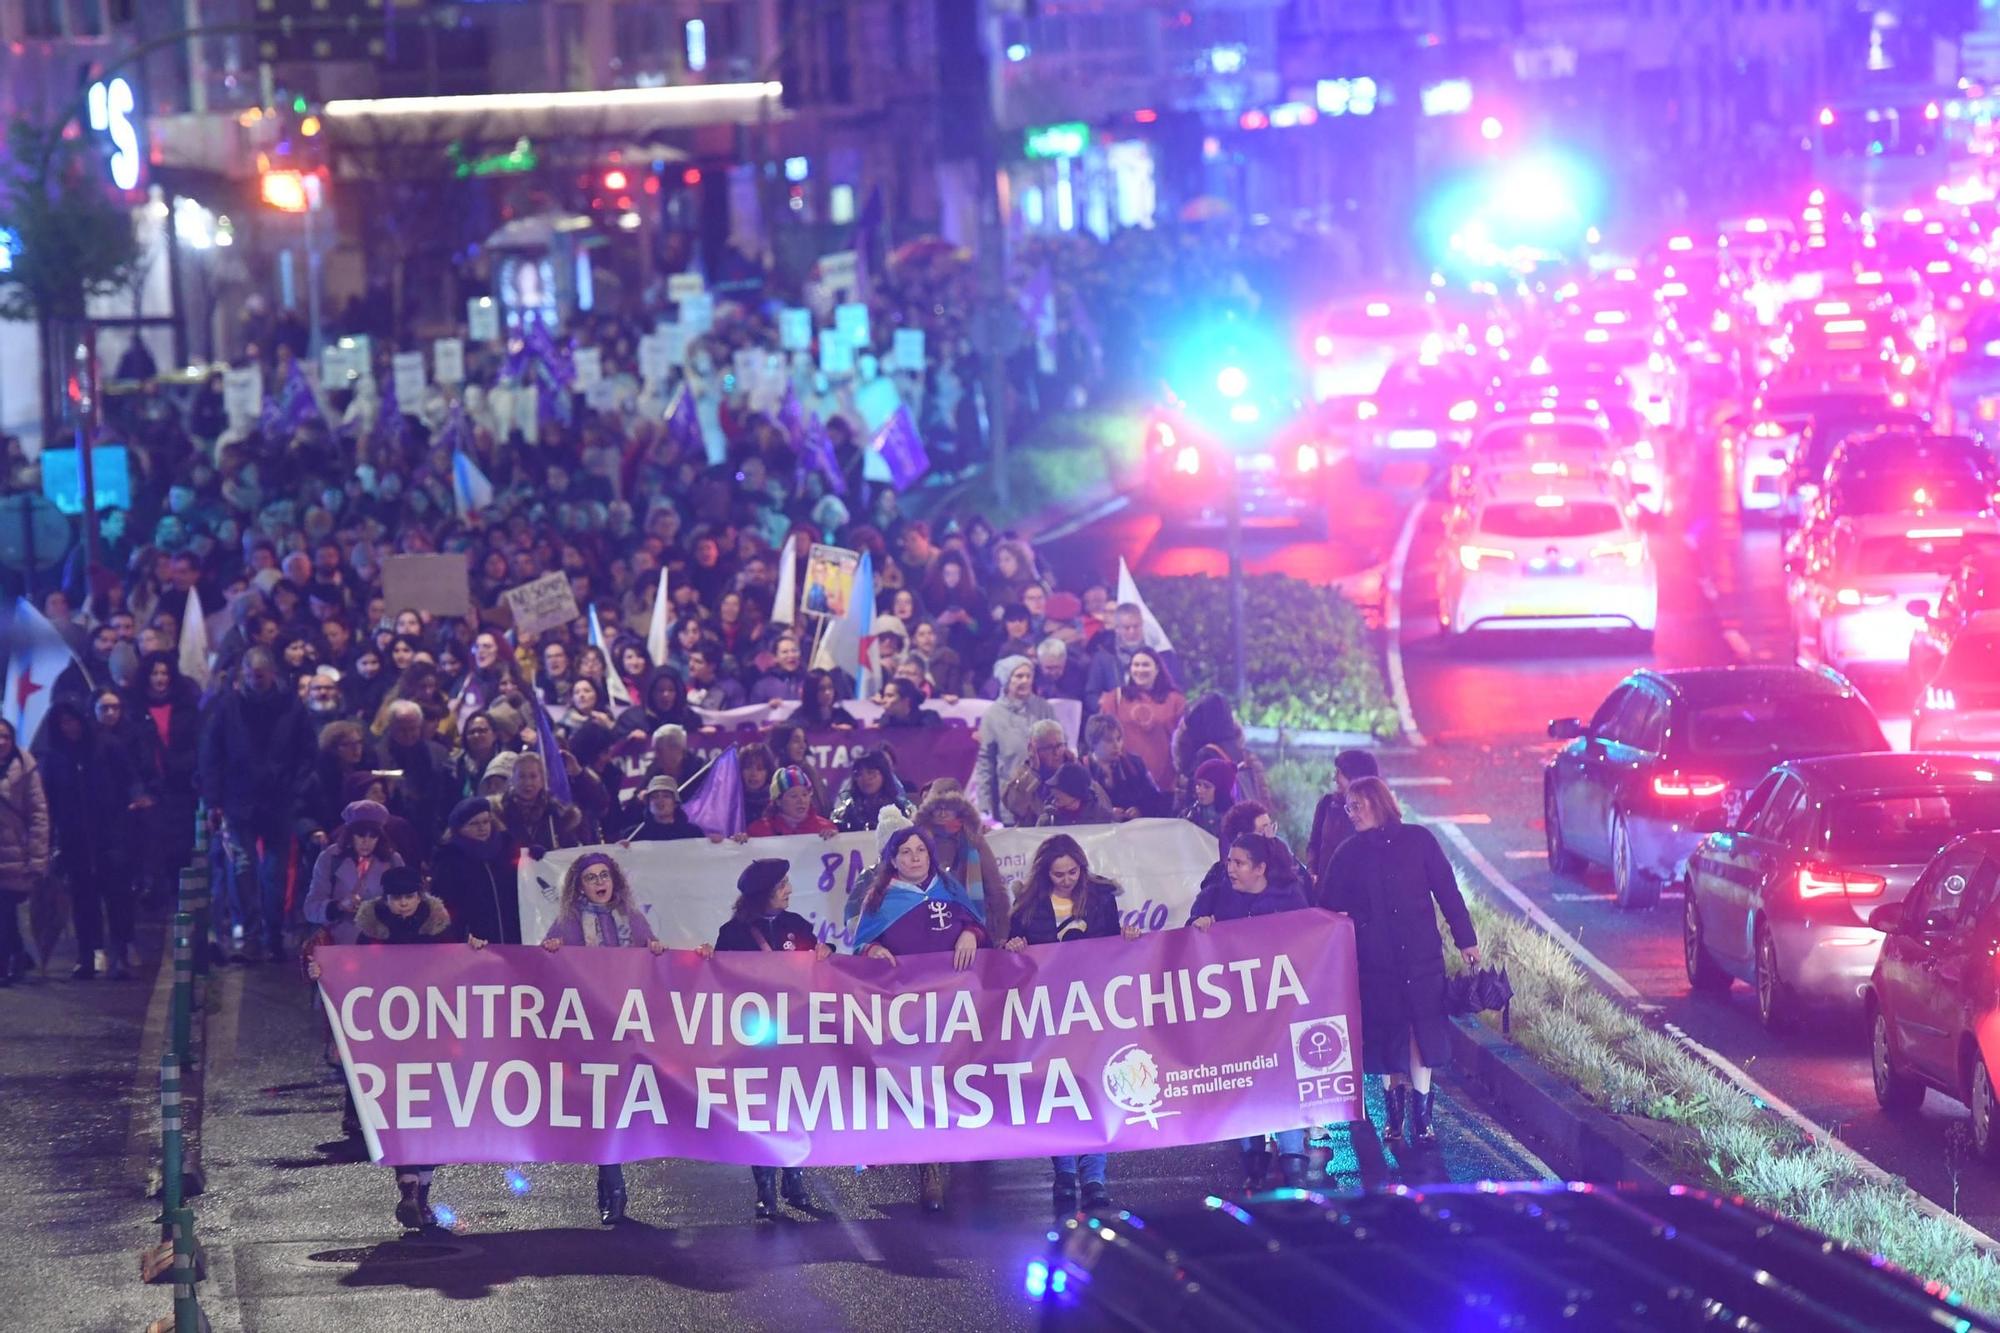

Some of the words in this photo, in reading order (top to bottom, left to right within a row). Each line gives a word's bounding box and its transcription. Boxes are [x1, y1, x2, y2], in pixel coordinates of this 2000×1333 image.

[341, 985, 594, 1041] CONTRA
[612, 989, 655, 1042] A
[670, 990, 983, 1046] VIOLENCIA
[1001, 954, 1310, 1041] MACHISTA
[1165, 1064, 1218, 1083] marcha
[1221, 1053, 1279, 1075] mundial
[351, 1060, 668, 1129] REVOLTA
[695, 1057, 1092, 1132] FEMINISTA
[1163, 1083, 1189, 1098] das
[1192, 1076, 1254, 1095] mulleres
[1298, 1075, 1355, 1102] PFG
